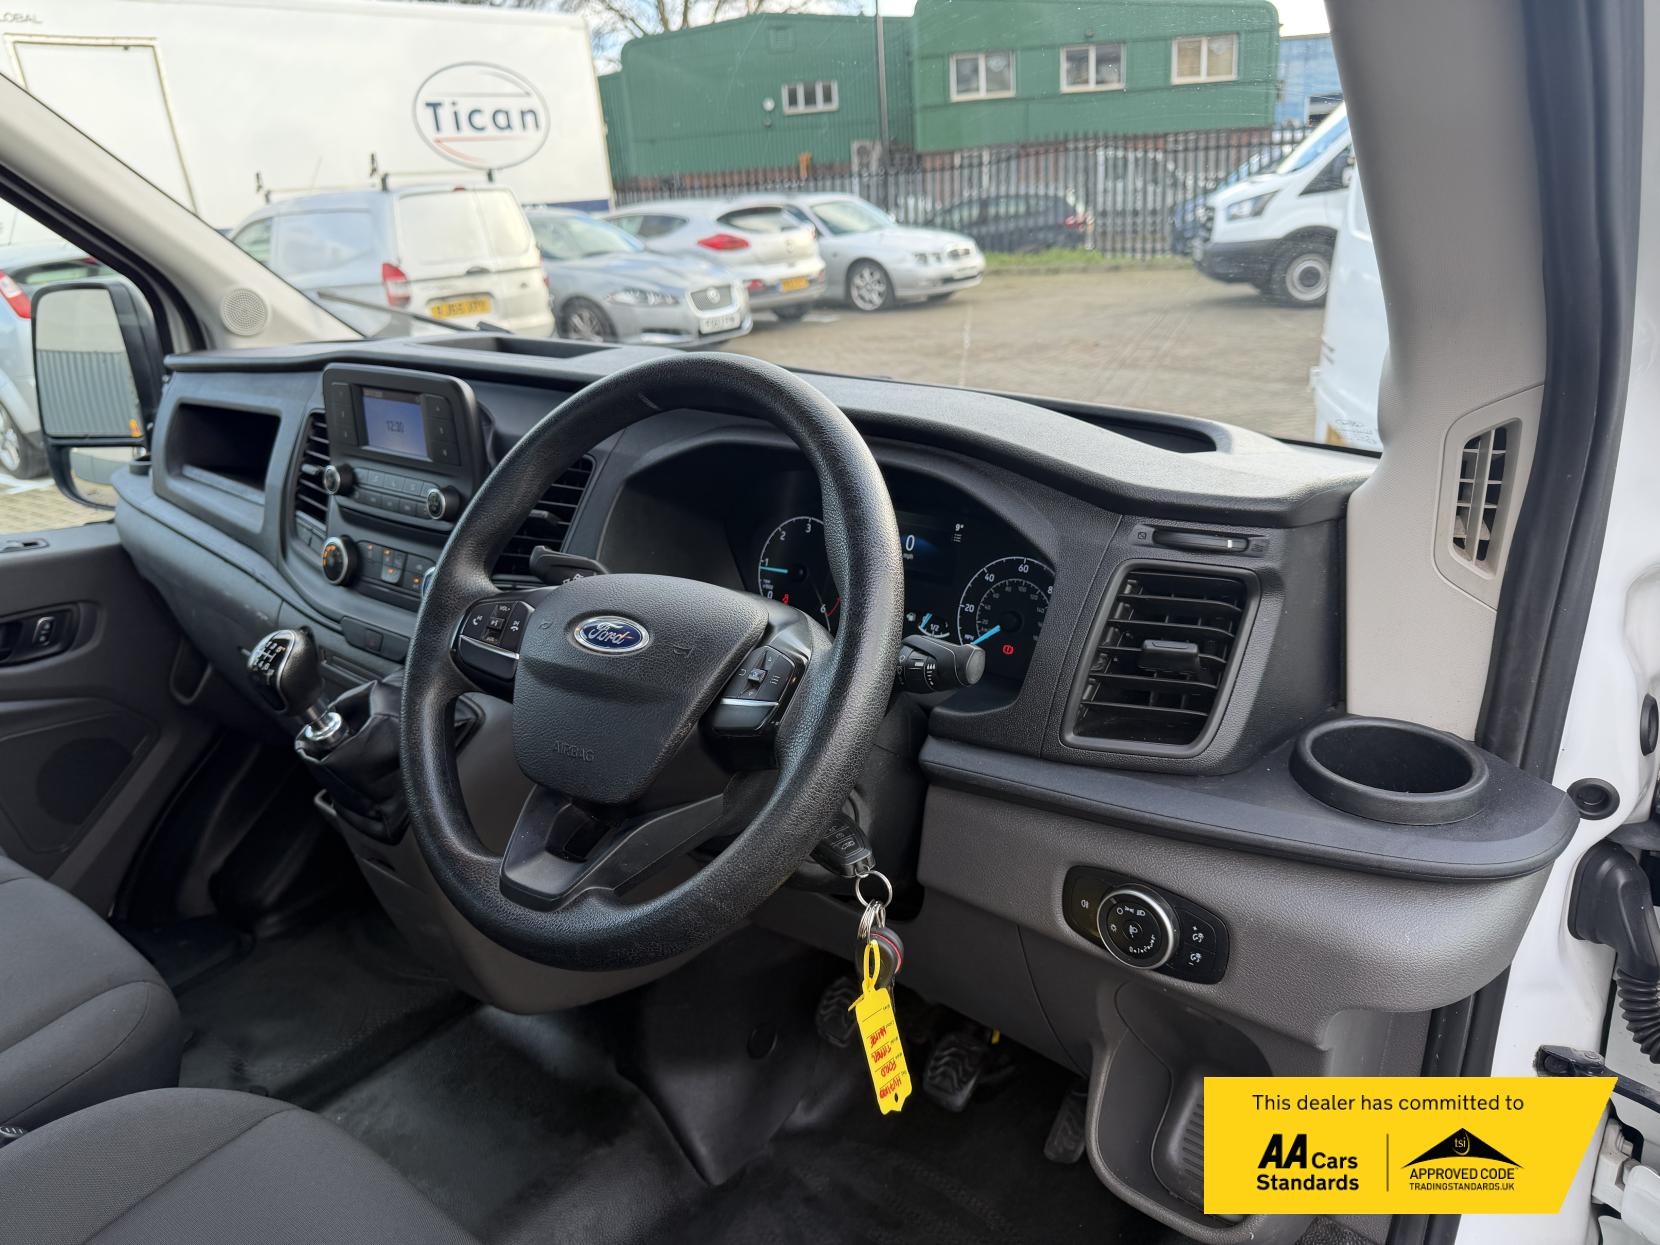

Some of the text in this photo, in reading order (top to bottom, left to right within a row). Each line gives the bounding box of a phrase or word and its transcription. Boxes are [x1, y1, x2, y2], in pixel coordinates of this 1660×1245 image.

[425, 102, 540, 132] Tican
[805, 523, 812, 533] 3
[779, 531, 786, 541] 2
[905, 534, 915, 551] 0
[1018, 564, 1029, 573] 60
[984, 573, 995, 582] 40
[1047, 585, 1053, 594] 8
[820, 603, 826, 613] 6
[964, 603, 975, 613] 20
[588, 622, 632, 645] Ford
[881, 1060, 897, 1077] FORD
